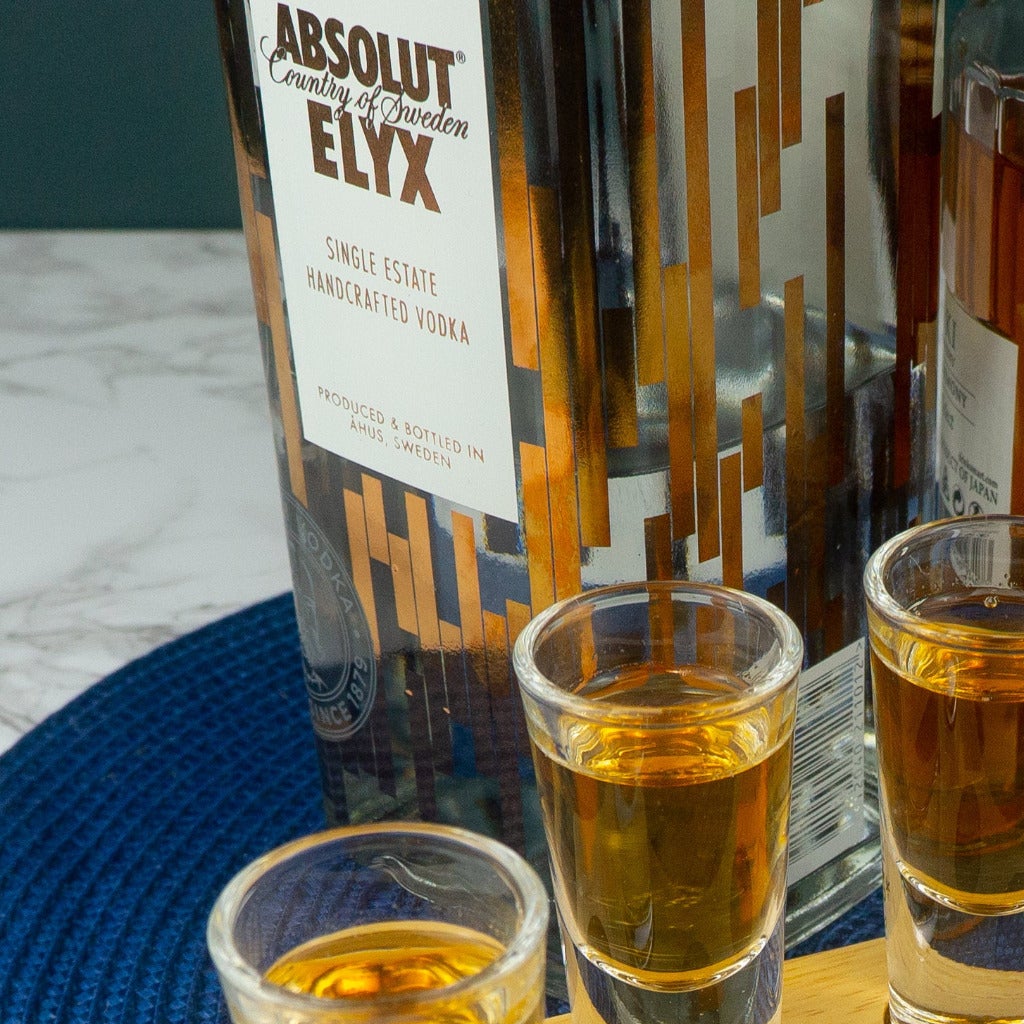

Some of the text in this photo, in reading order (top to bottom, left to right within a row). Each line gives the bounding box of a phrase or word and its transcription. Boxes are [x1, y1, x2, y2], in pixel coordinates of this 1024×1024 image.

[260, 35, 469, 139] Country of Sweden
[306, 98, 442, 214] ELYX
[325, 235, 438, 297] SINGLE ESTATE
[306, 265, 470, 346] HANDCRAFTED VODKA
[317, 385, 485, 464] PRODUCED & BOTTLED IN
[394, 436, 452, 470] SWEDEN
[969, 475, 998, 506] JAPAN
[346, 655, 368, 710] 1879
